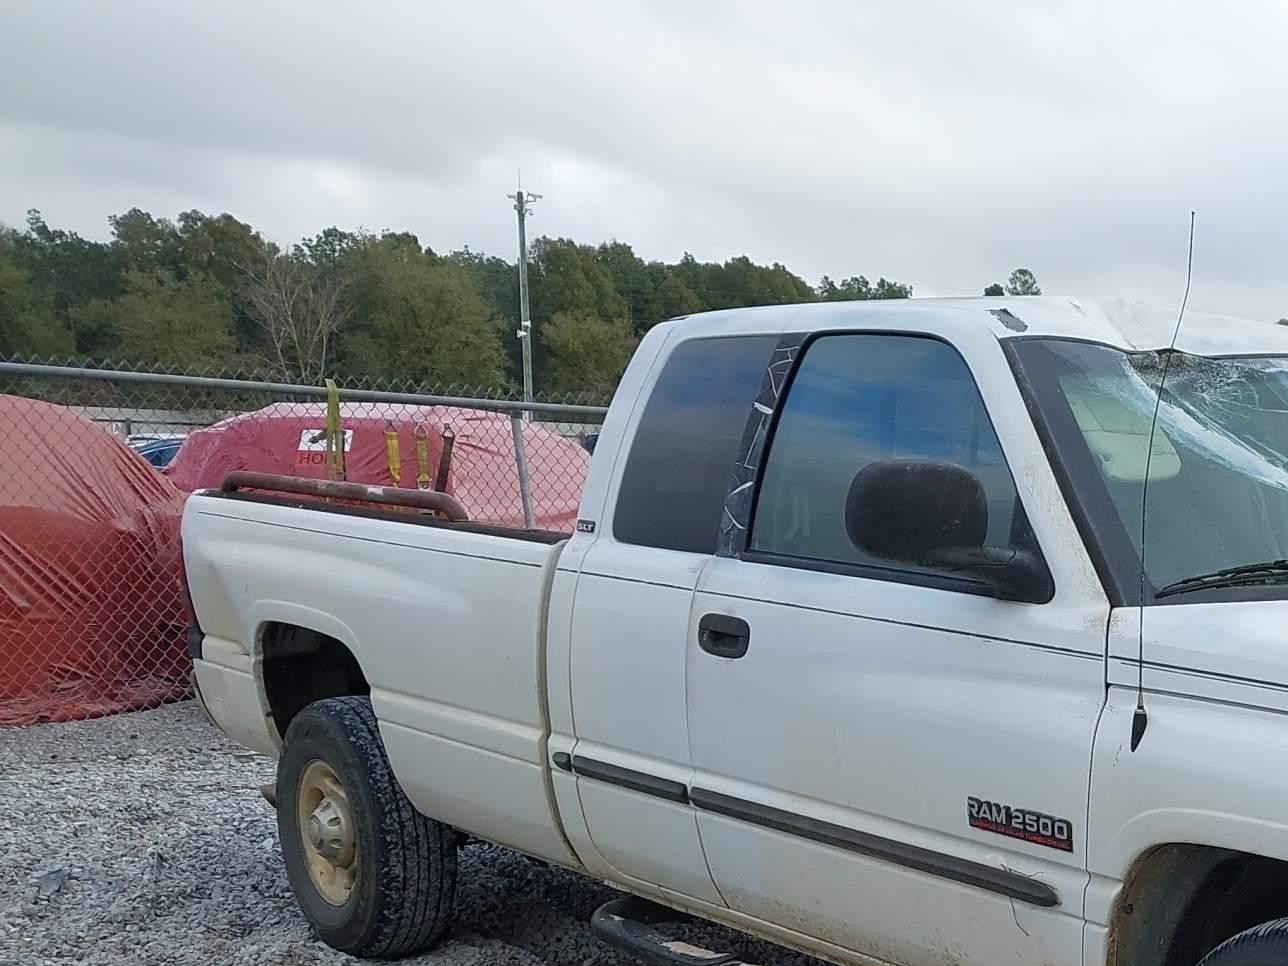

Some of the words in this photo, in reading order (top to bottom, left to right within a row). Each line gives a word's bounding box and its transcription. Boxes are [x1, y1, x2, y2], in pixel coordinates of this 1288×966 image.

[577, 523, 593, 531] SLT
[967, 797, 1007, 826] RAM
[1011, 811, 1068, 841] 2500
